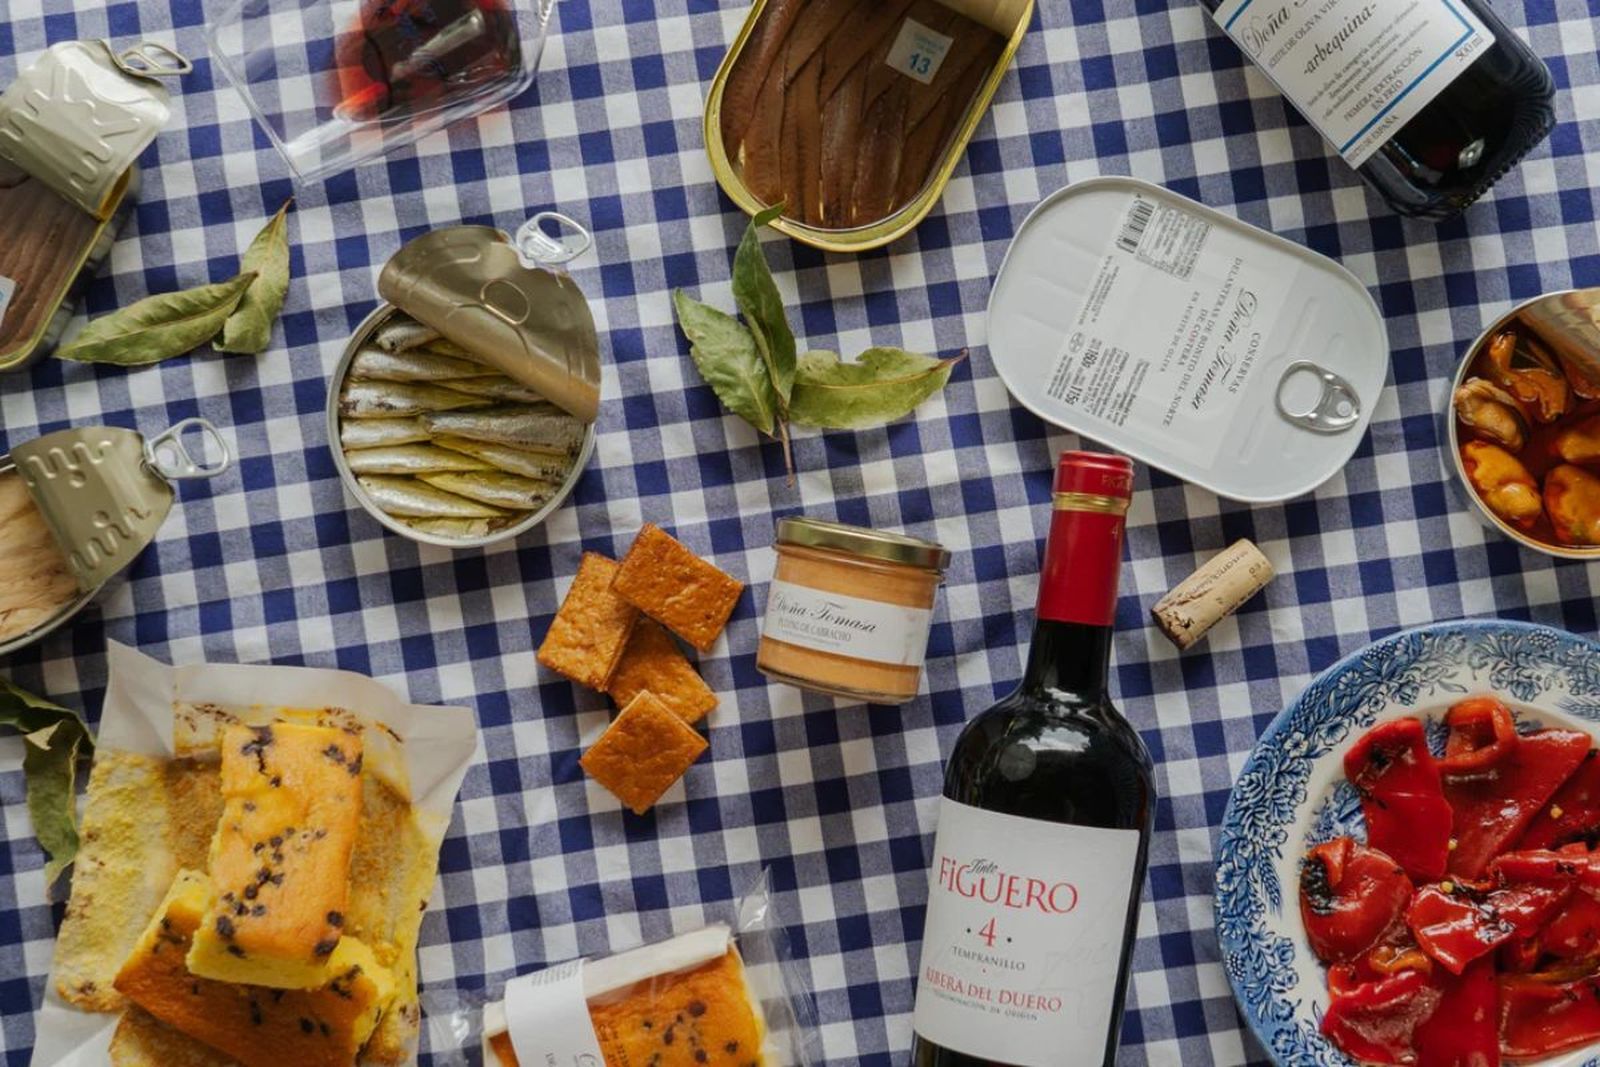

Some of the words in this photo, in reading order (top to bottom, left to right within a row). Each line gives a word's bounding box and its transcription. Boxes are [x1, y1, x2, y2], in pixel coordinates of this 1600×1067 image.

[1241, 6, 1290, 58] Doña
[1294, 14, 1321, 40] OLIVA
[910, 53, 931, 75] 13
[1455, 43, 1472, 62] 500
[1344, 93, 1374, 121] PRIMERA
[1372, 50, 1422, 95] EXTRACCIÓN
[1371, 97, 1384, 110] EN
[1211, 257, 1243, 317] DELANTERAS
[1177, 305, 1194, 333] ACEITE
[1196, 309, 1208, 322] DE
[1204, 320, 1215, 333] DE
[1223, 288, 1258, 342] Doña
[1177, 324, 1201, 366] COSTERA
[1187, 335, 1208, 372] BONITO
[1191, 345, 1233, 410] Tomasa
[1228, 332, 1261, 394] CONSERVAS
[1178, 373, 1191, 391] DEL
[1163, 394, 1182, 427] NORTE
[810, 600, 877, 632] Tomasa
[967, 858, 999, 874] Tinto
[978, 916, 997, 947] 4
[952, 946, 1025, 971] TEMPRANILLO
[968, 984, 992, 1001] DEL
[999, 989, 1062, 1012] DUERO
